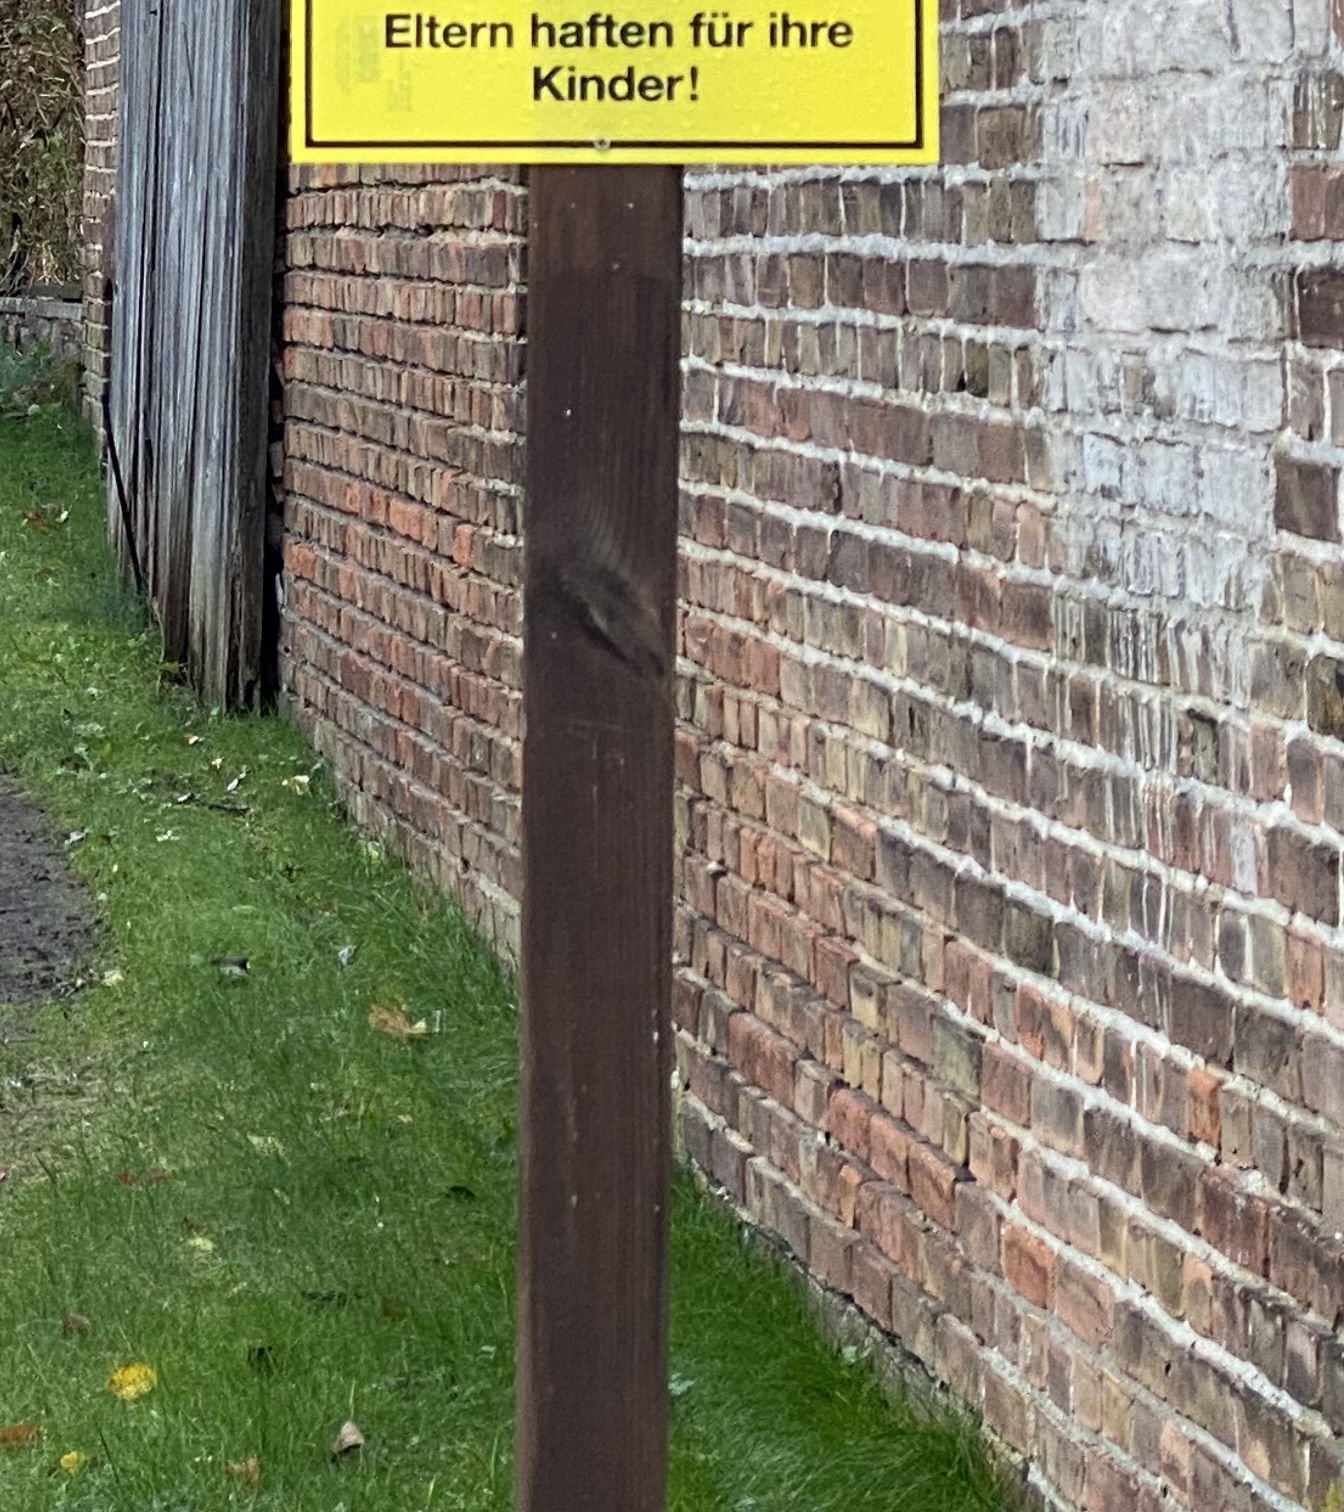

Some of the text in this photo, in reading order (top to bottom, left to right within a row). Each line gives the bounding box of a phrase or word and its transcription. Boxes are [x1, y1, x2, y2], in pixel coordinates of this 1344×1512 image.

[385, 12, 853, 49] Eltern haften für ihre
[533, 65, 698, 102] Kinder!
